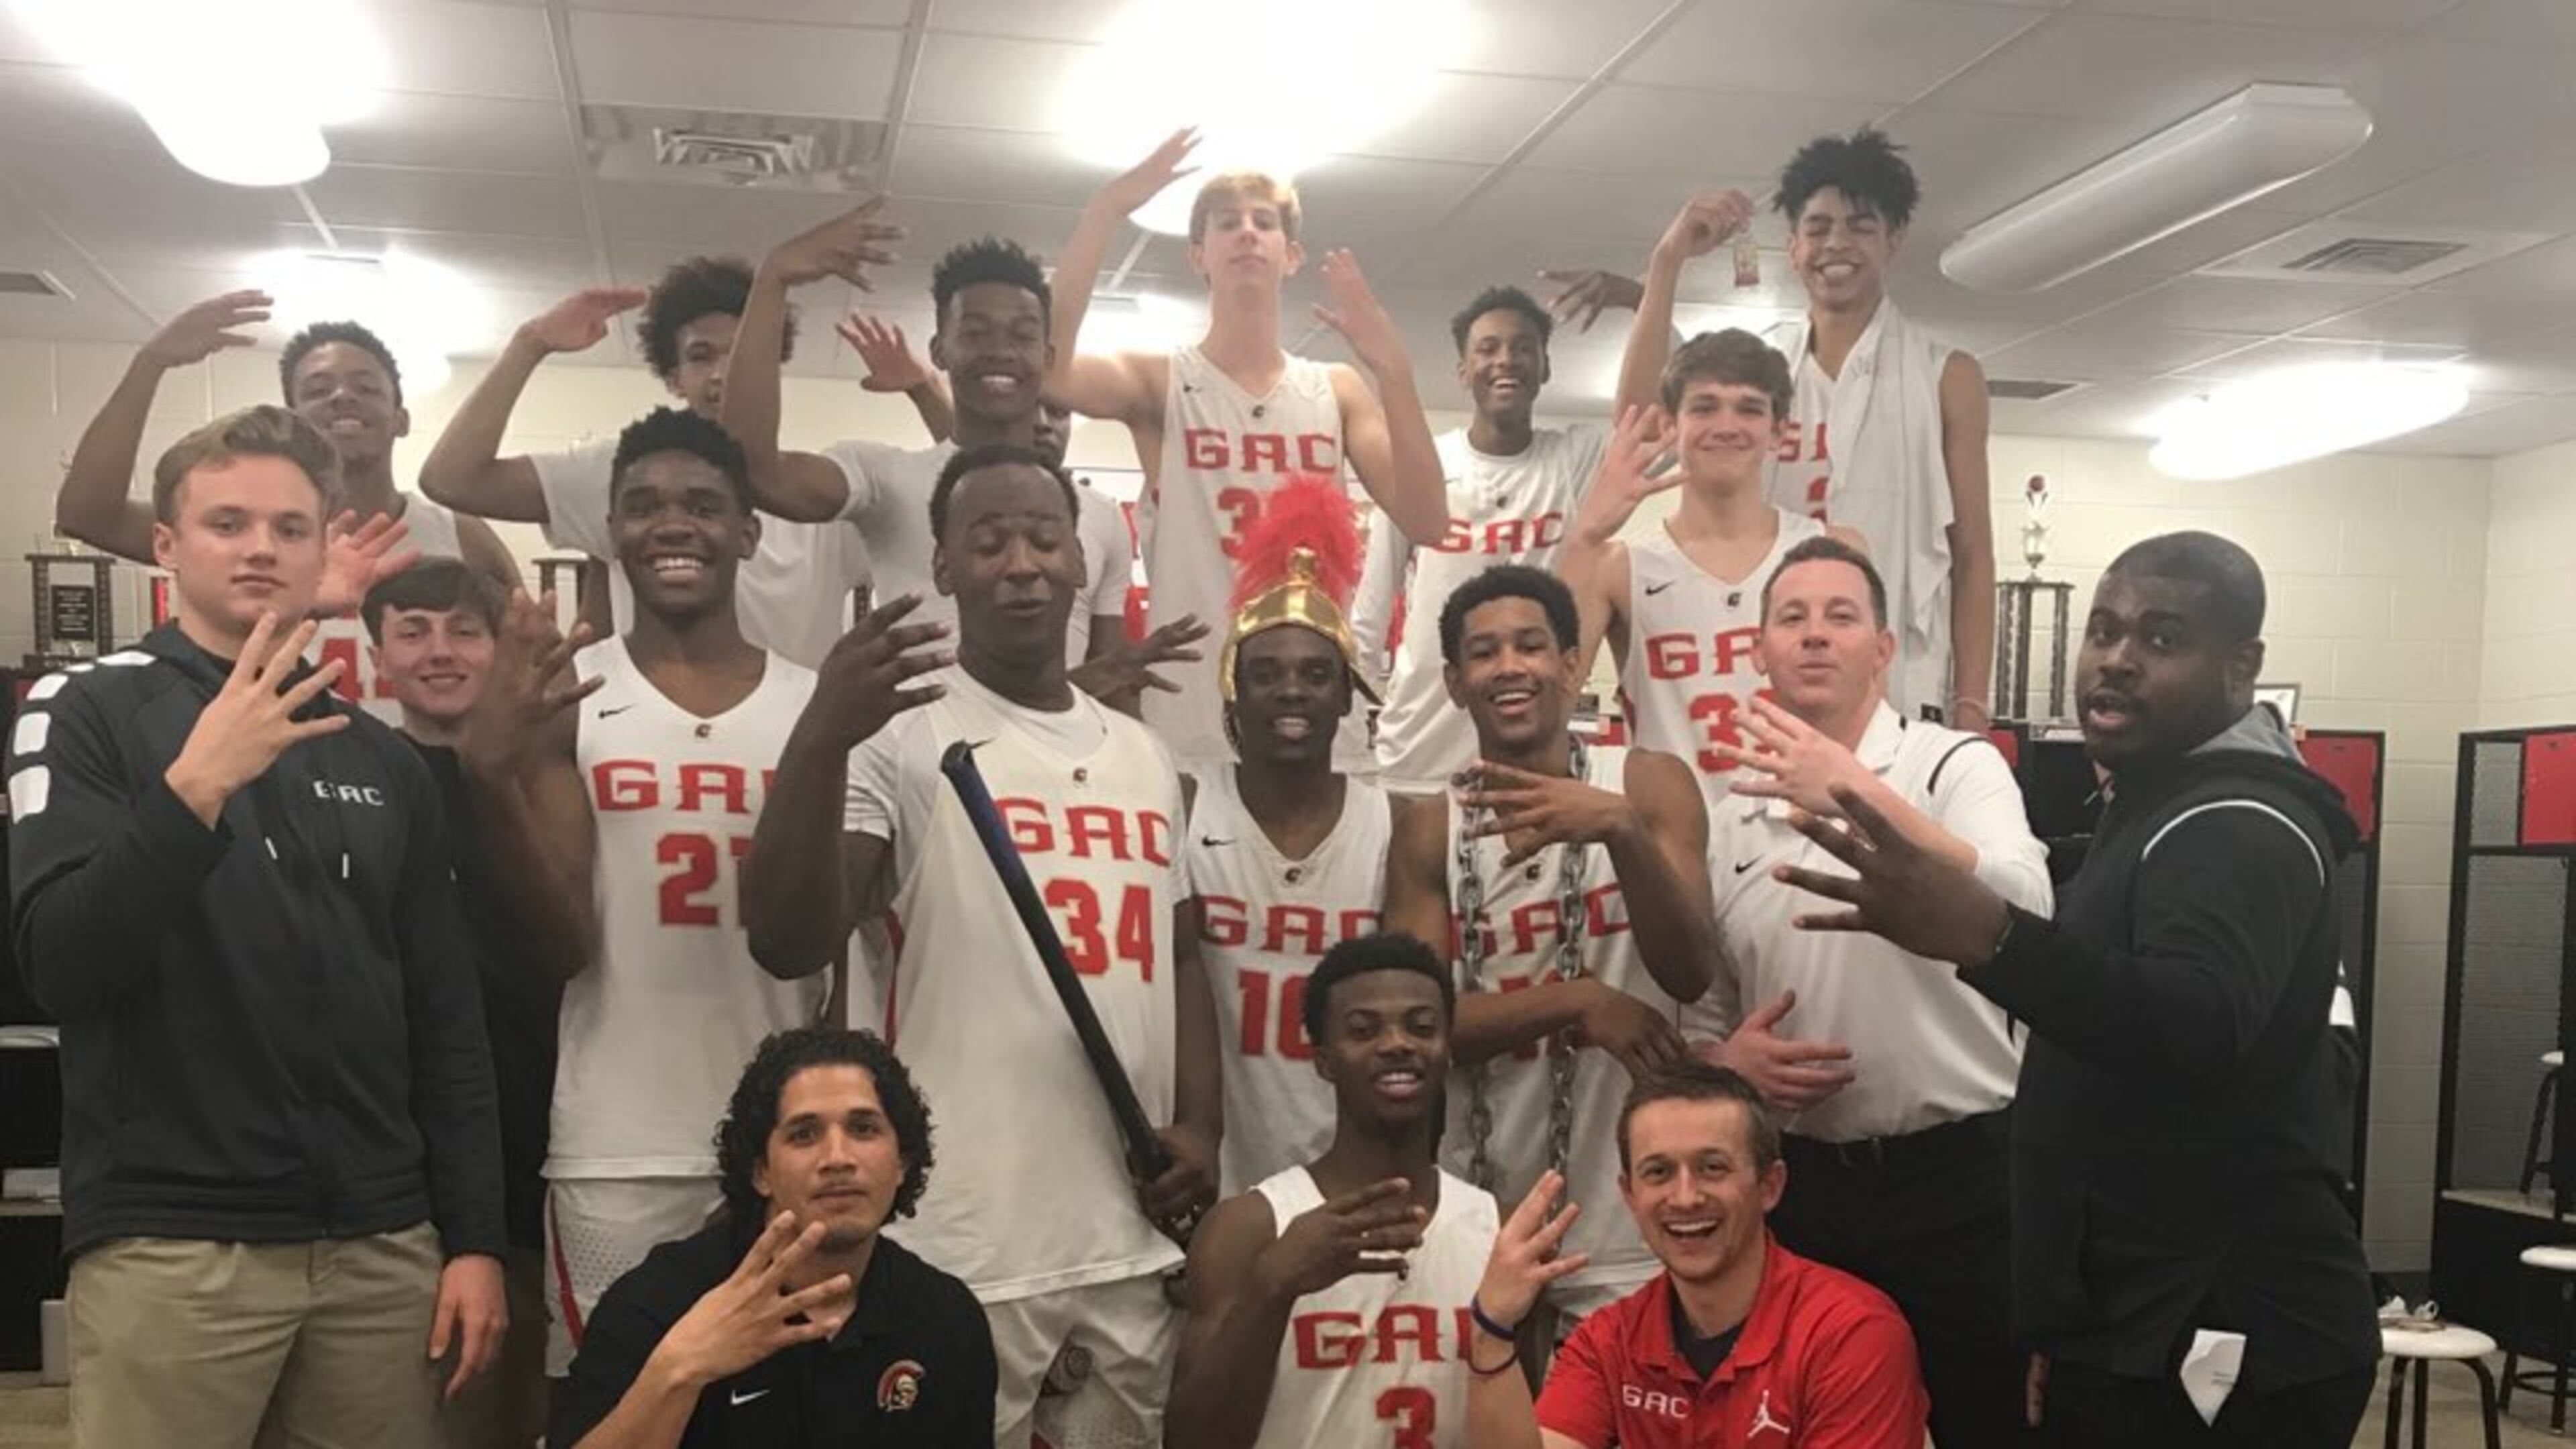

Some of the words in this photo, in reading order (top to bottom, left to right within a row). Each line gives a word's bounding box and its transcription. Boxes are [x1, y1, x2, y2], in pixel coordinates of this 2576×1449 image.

[1185, 429, 1337, 473] GAC
[1218, 488, 1268, 558] 3
[1646, 627, 1762, 680] GA
[313, 780, 384, 806] GAC
[993, 798, 1170, 867] GAC
[1044, 878, 1155, 983] 34
[1375, 1387, 1436, 1449] 3
[1622, 1384, 1690, 1420] GAC
